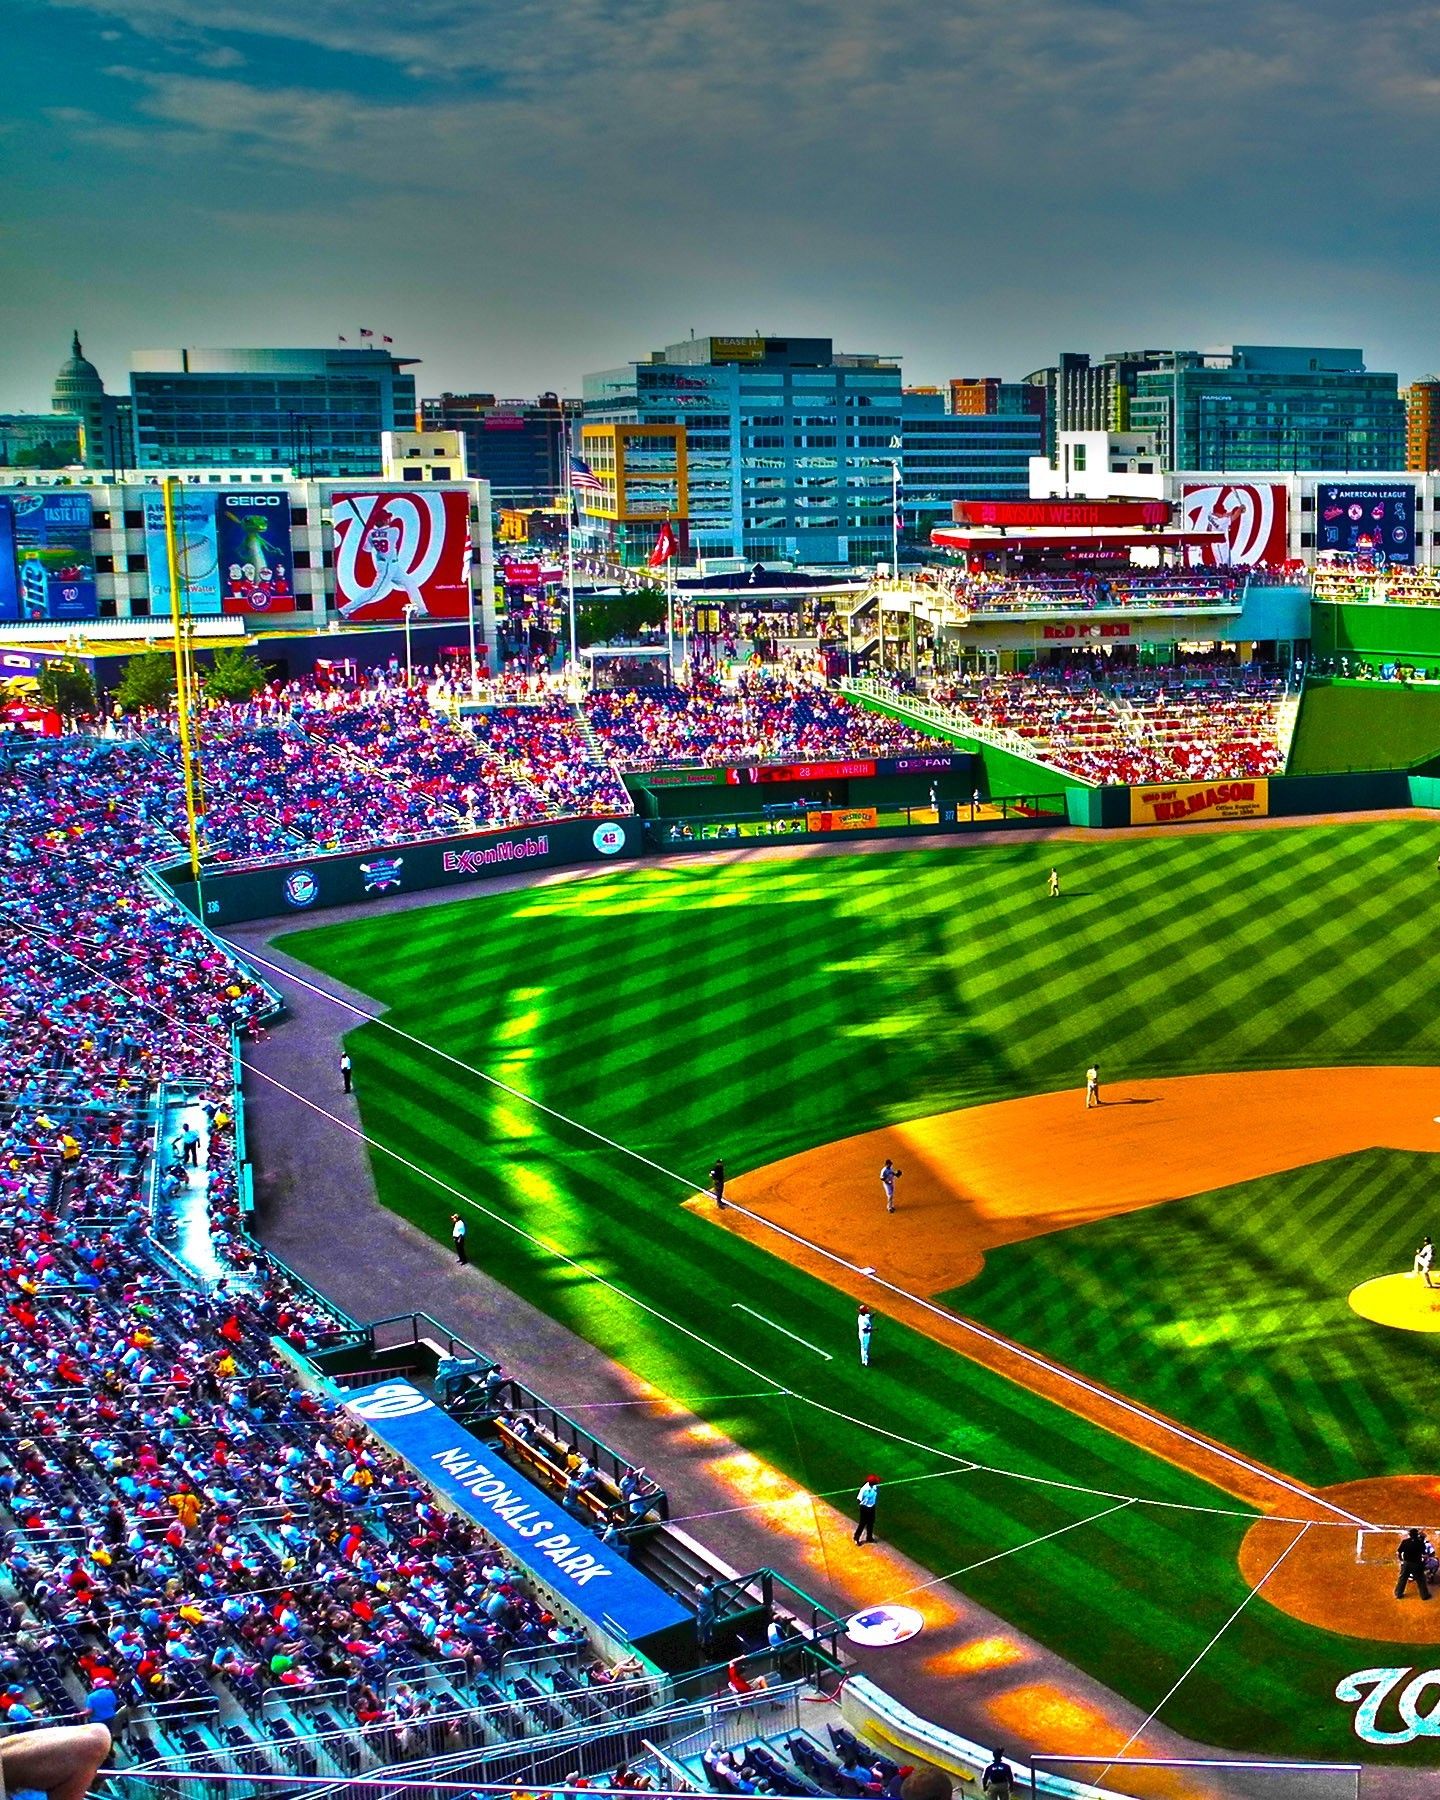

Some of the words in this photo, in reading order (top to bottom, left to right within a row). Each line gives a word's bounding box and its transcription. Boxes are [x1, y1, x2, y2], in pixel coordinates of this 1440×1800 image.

[226, 496, 280, 506] GEICO
[1049, 505, 1099, 522] WERTH
[602, 833, 616, 843] 42
[443, 835, 549, 873] ExxonMobil
[430, 1447, 554, 1538] NATIONALS
[534, 1533, 613, 1586] PARK
